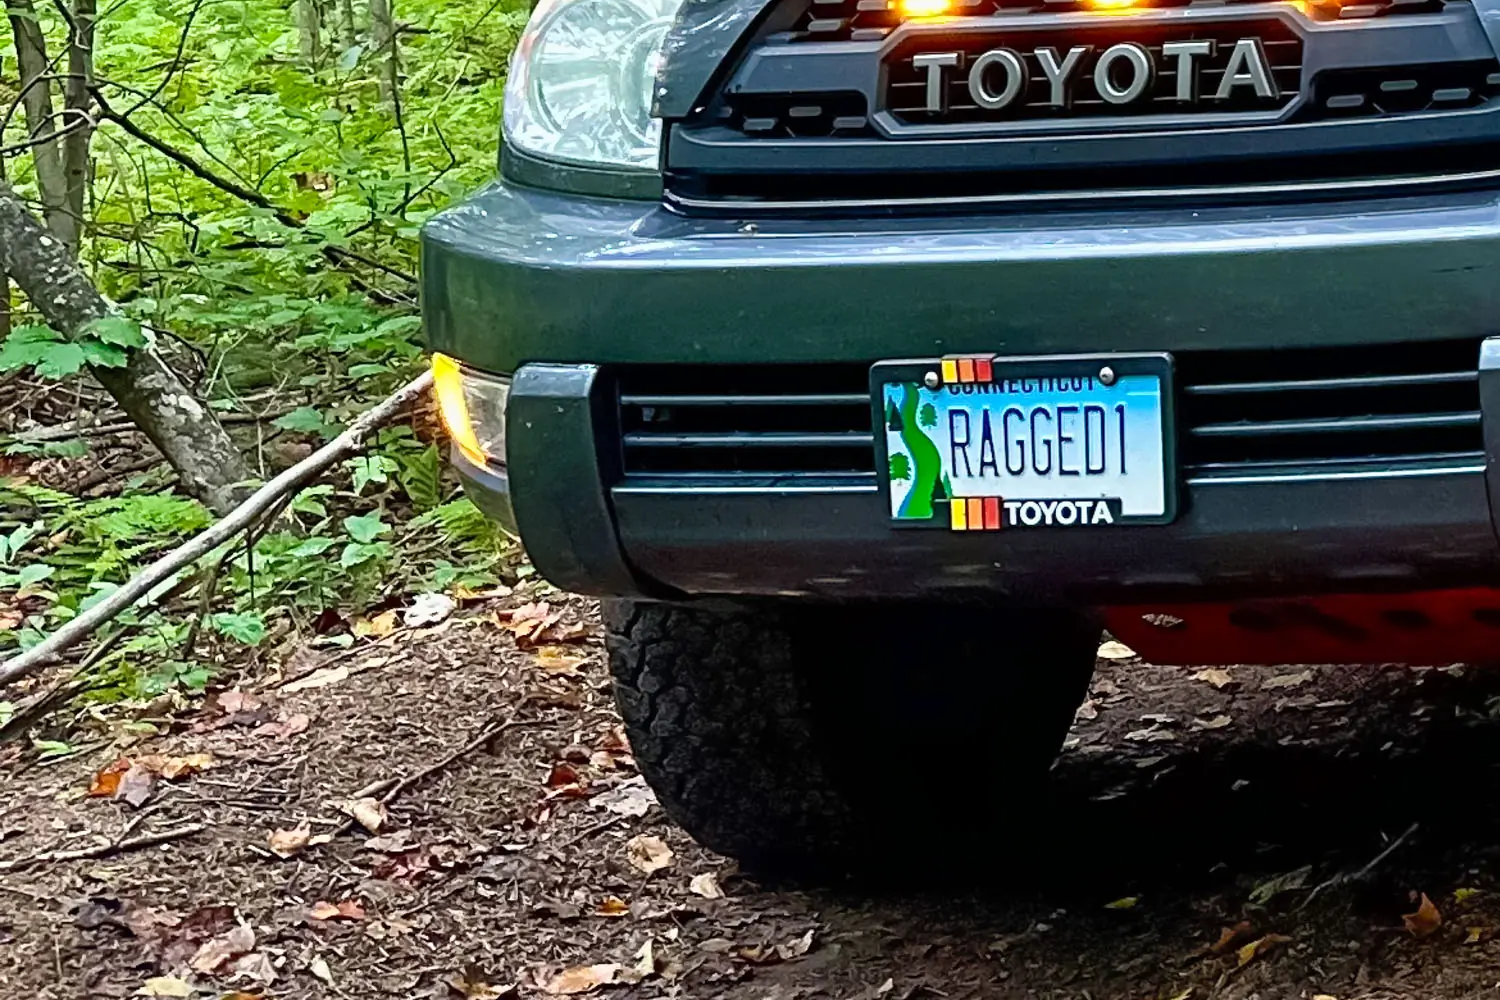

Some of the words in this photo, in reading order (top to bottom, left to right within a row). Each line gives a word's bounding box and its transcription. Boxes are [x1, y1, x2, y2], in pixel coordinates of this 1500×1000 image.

[912, 37, 1279, 113] TOYOTA
[948, 403, 1128, 478] RAGGED1
[1004, 501, 1113, 526] TOYOTA
